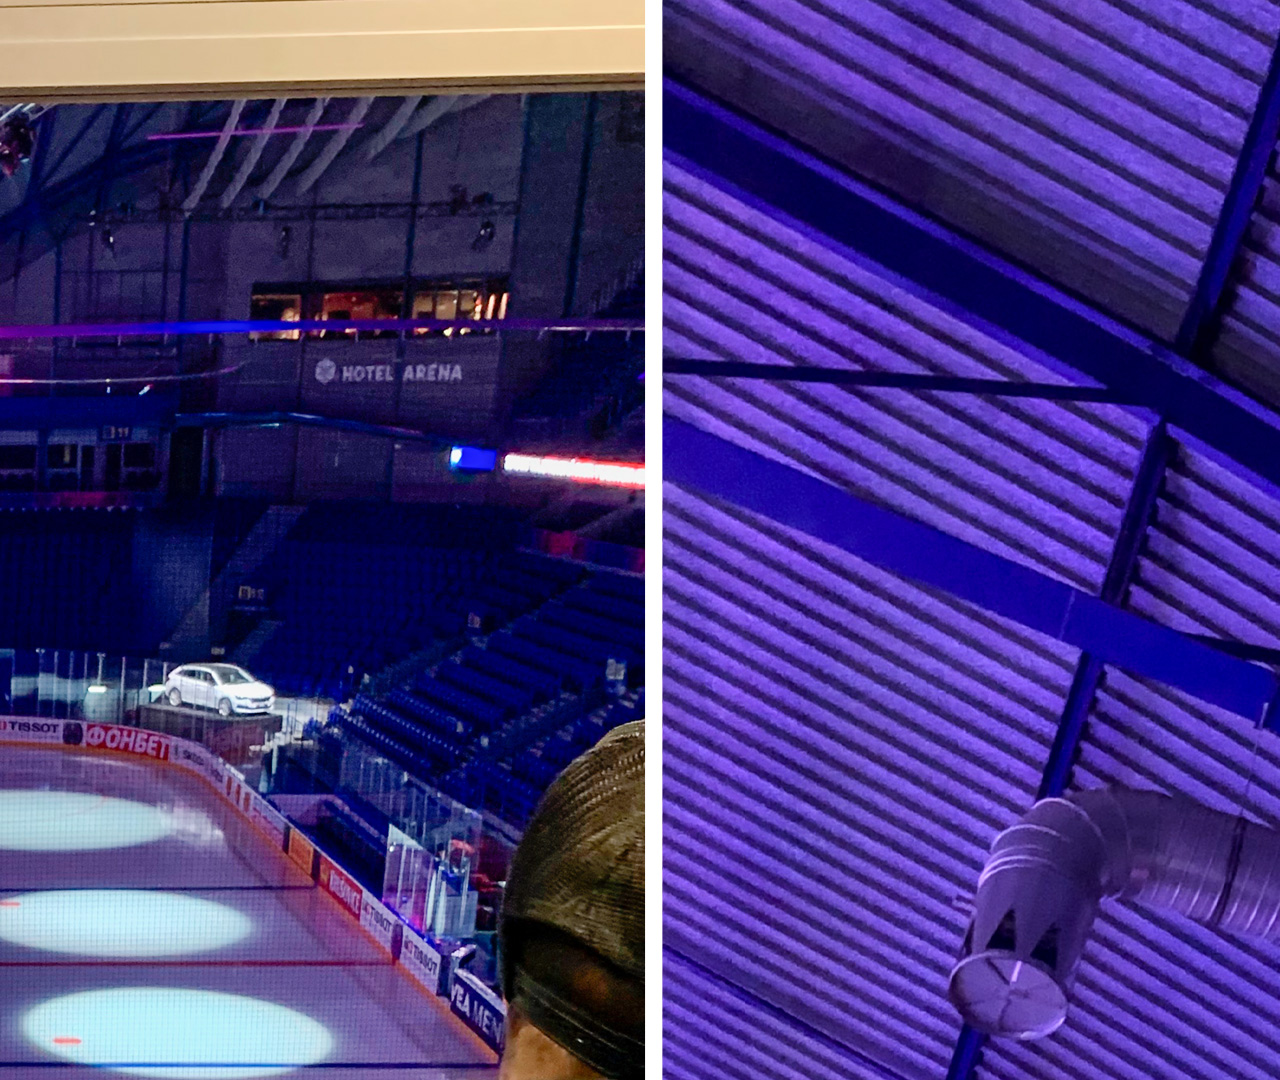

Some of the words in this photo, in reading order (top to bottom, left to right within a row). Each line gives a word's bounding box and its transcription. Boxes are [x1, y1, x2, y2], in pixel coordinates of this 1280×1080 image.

[342, 365, 394, 382] HOTEL
[9, 720, 60, 734] TISSOT
[86, 726, 170, 760] ФОНБЕТ
